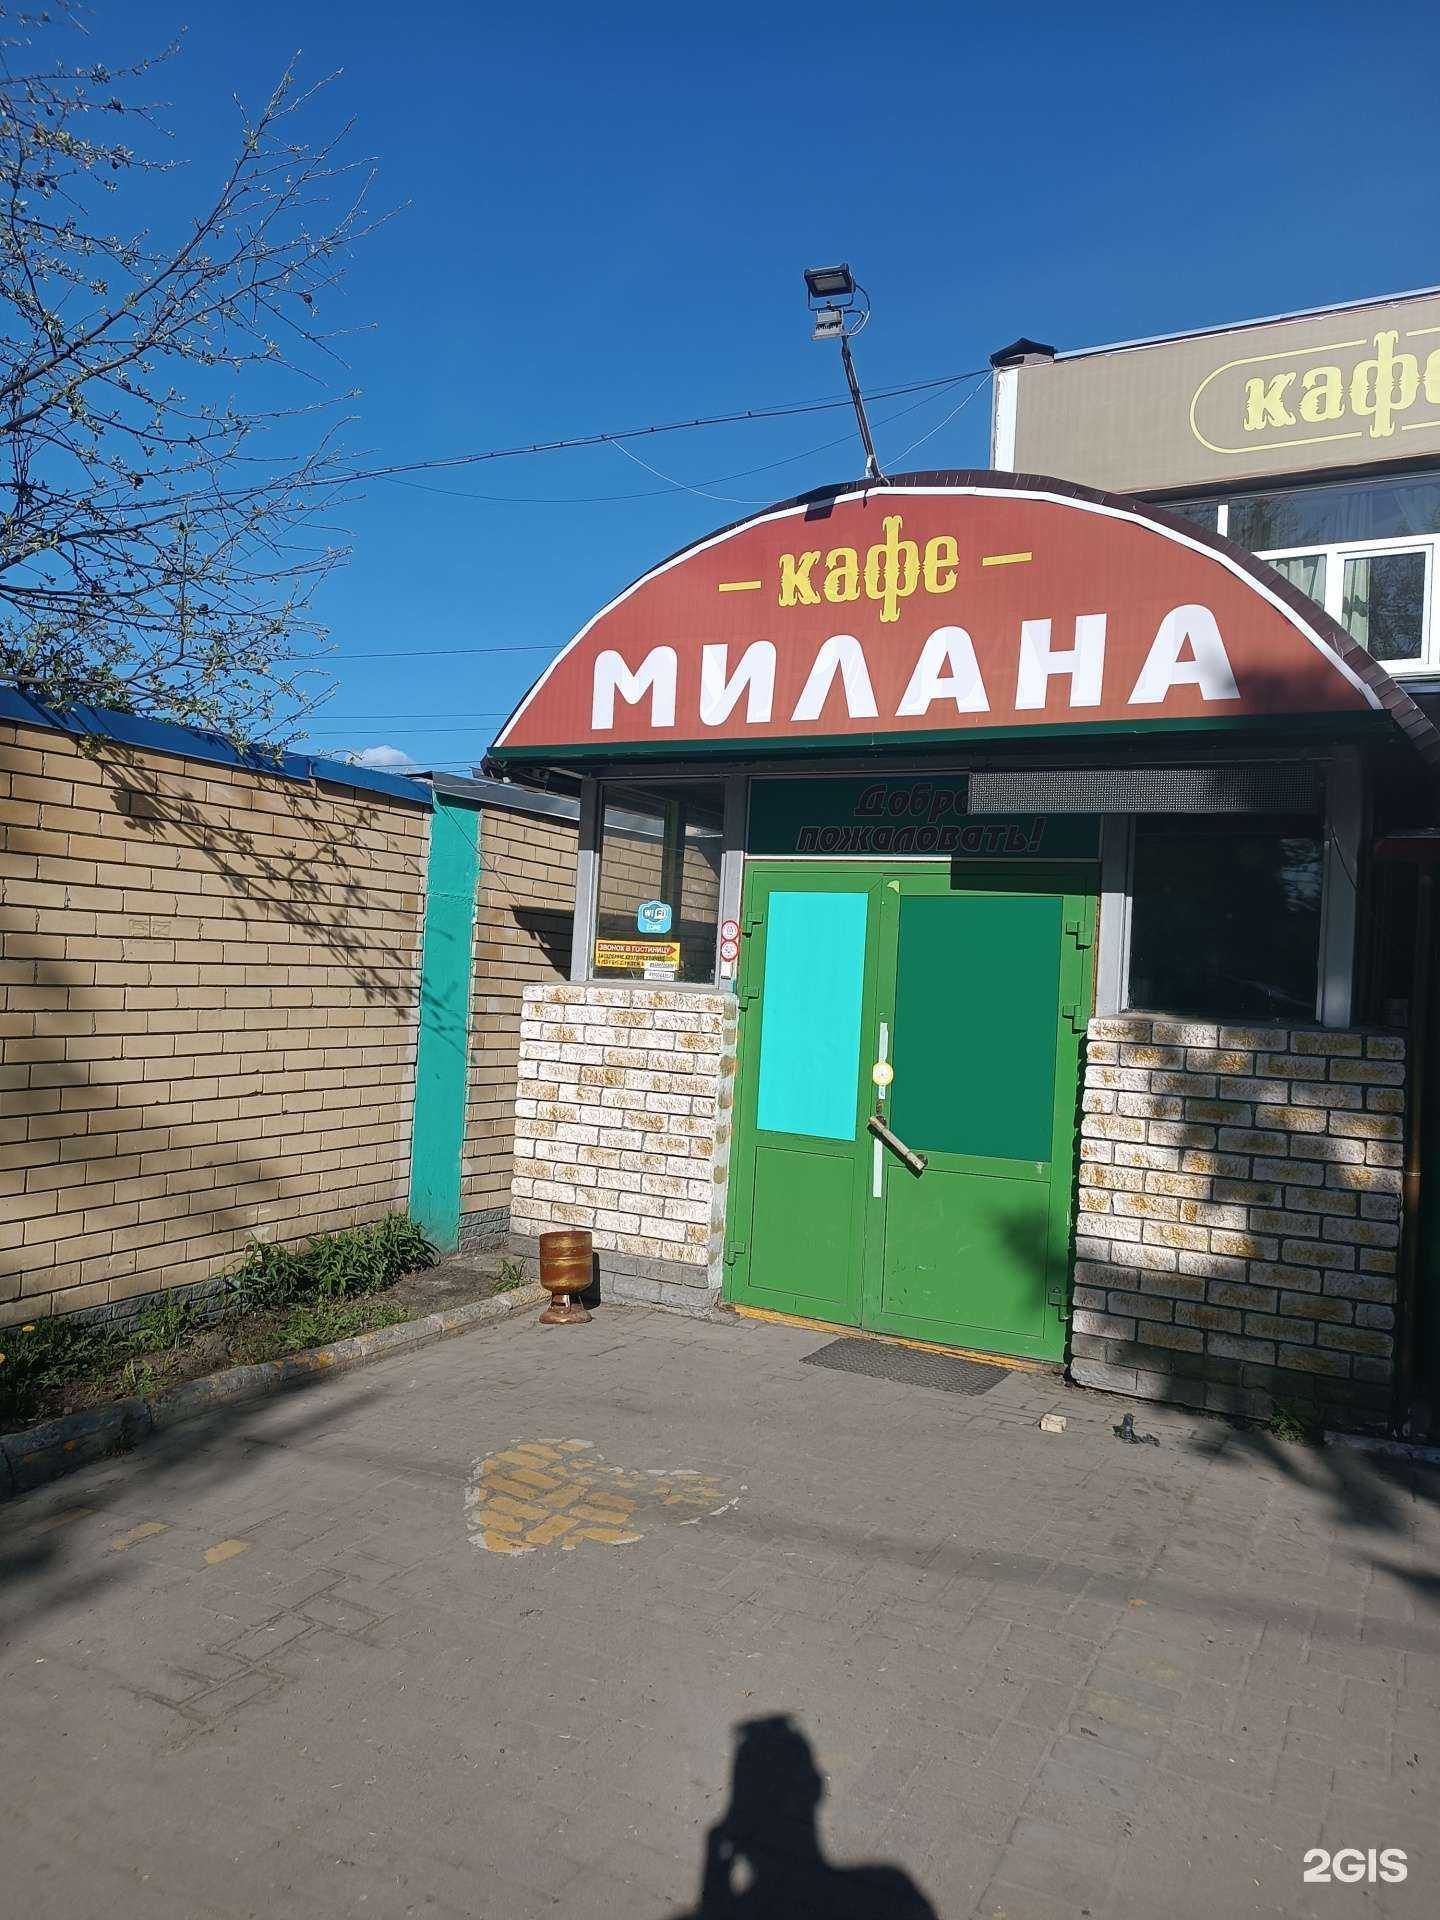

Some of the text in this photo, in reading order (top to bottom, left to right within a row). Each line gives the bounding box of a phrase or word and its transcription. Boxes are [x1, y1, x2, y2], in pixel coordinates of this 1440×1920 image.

[778, 515, 959, 622] кафе
[591, 604, 1242, 730] МИЛАНА
[796, 817, 1047, 852] пожаловать!
[599, 943, 670, 954] ЗВОНОК В ГОСТИНИЦУ
